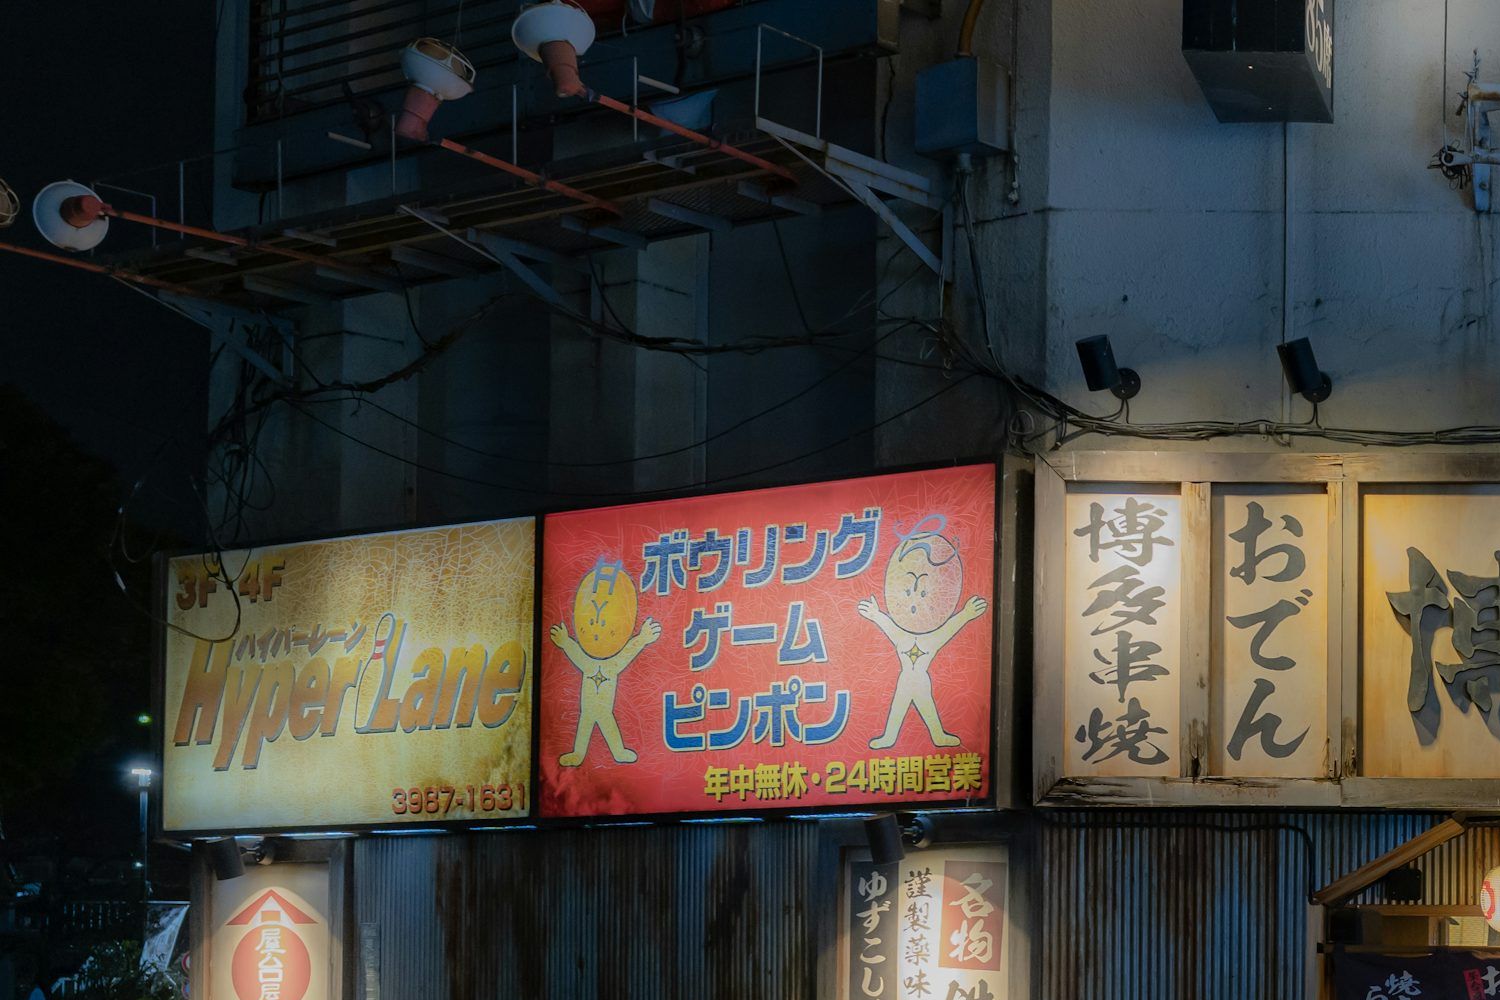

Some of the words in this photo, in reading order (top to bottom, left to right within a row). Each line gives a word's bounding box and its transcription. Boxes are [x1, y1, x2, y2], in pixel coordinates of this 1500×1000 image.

[640, 506, 882, 595] ボウリング
[234, 621, 367, 663] ハイパーレーン
[684, 601, 829, 672] ゲーム
[1073, 497, 1174, 765] 博多串焼
[1226, 501, 1313, 761] おでん
[173, 639, 361, 771] Hyper
[362, 618, 526, 734] Lane
[663, 675, 850, 752] ピンポン
[391, 783, 527, 815] 3987-1631
[704, 752, 983, 801] 年中無休・24時間営業
[903, 867, 933, 999] 謹製薬味
[949, 873, 996, 964] 名物
